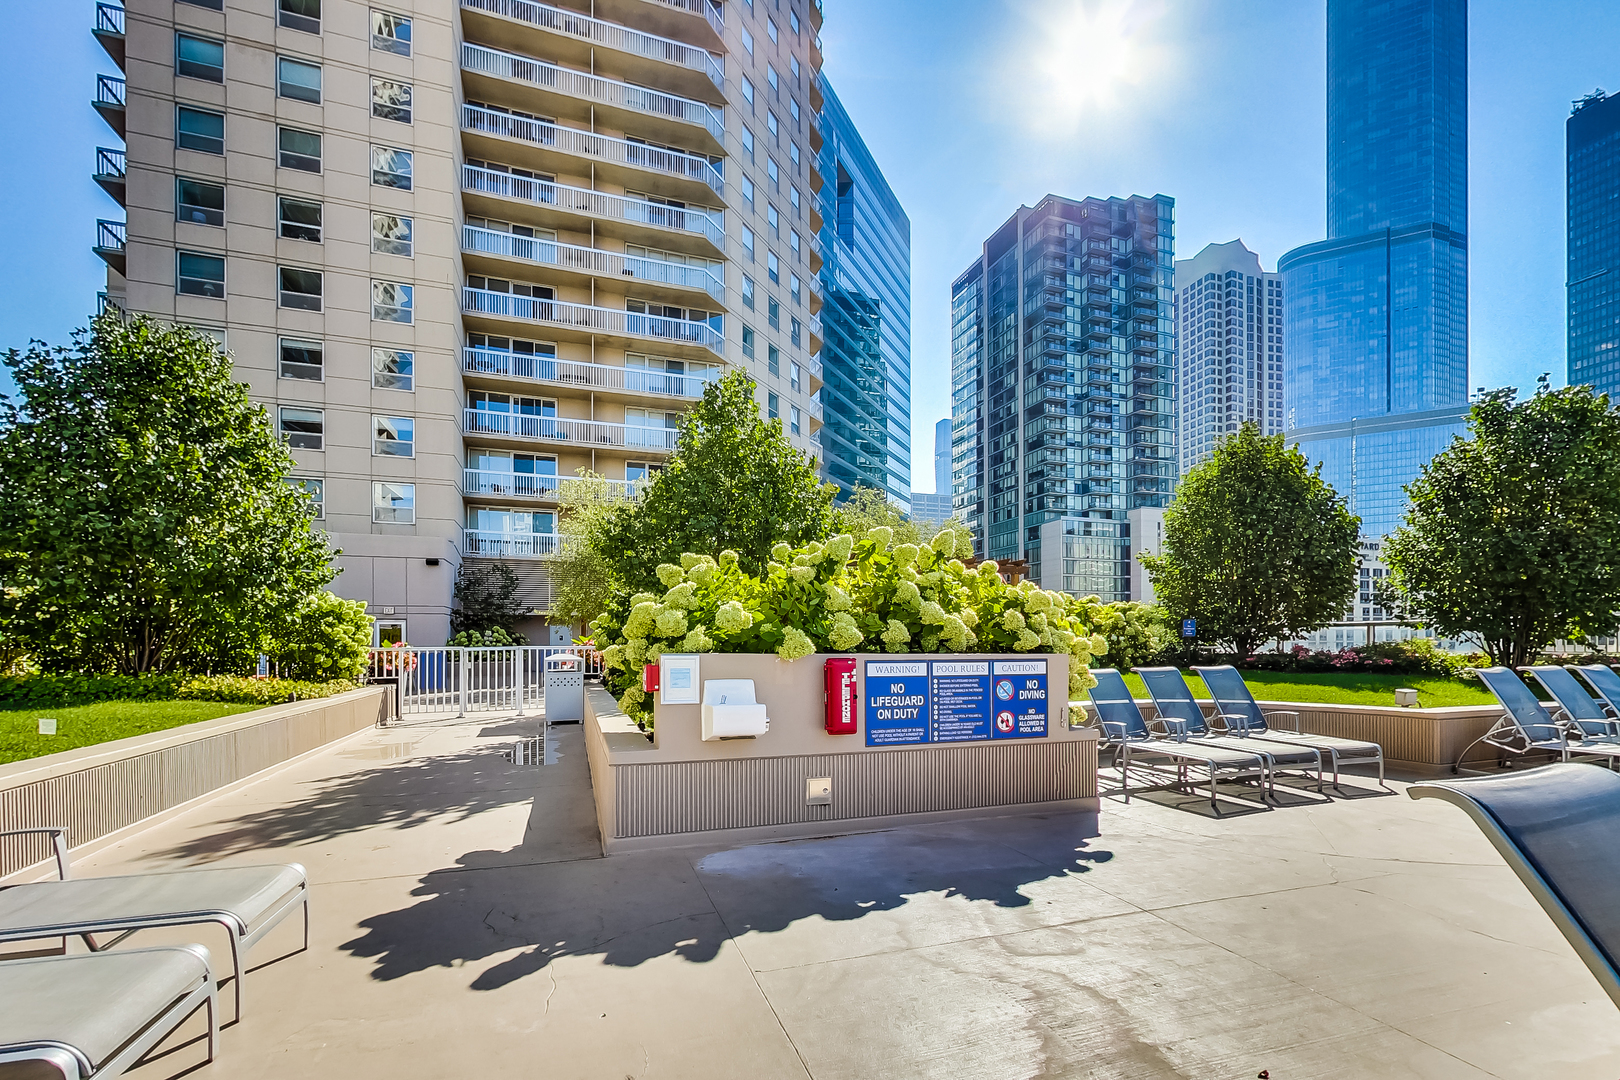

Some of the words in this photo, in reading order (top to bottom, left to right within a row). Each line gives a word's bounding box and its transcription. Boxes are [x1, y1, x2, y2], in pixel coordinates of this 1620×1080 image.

[1361, 542, 1380, 550] ARD
[875, 666, 920, 674] WARNING!
[890, 683, 905, 694] NO
[1026, 680, 1038, 689] NO
[1019, 690, 1046, 700] DIVING
[871, 696, 924, 707] LIFEGUARD
[878, 709, 891, 719] ON
[894, 708, 918, 719] DUTY
